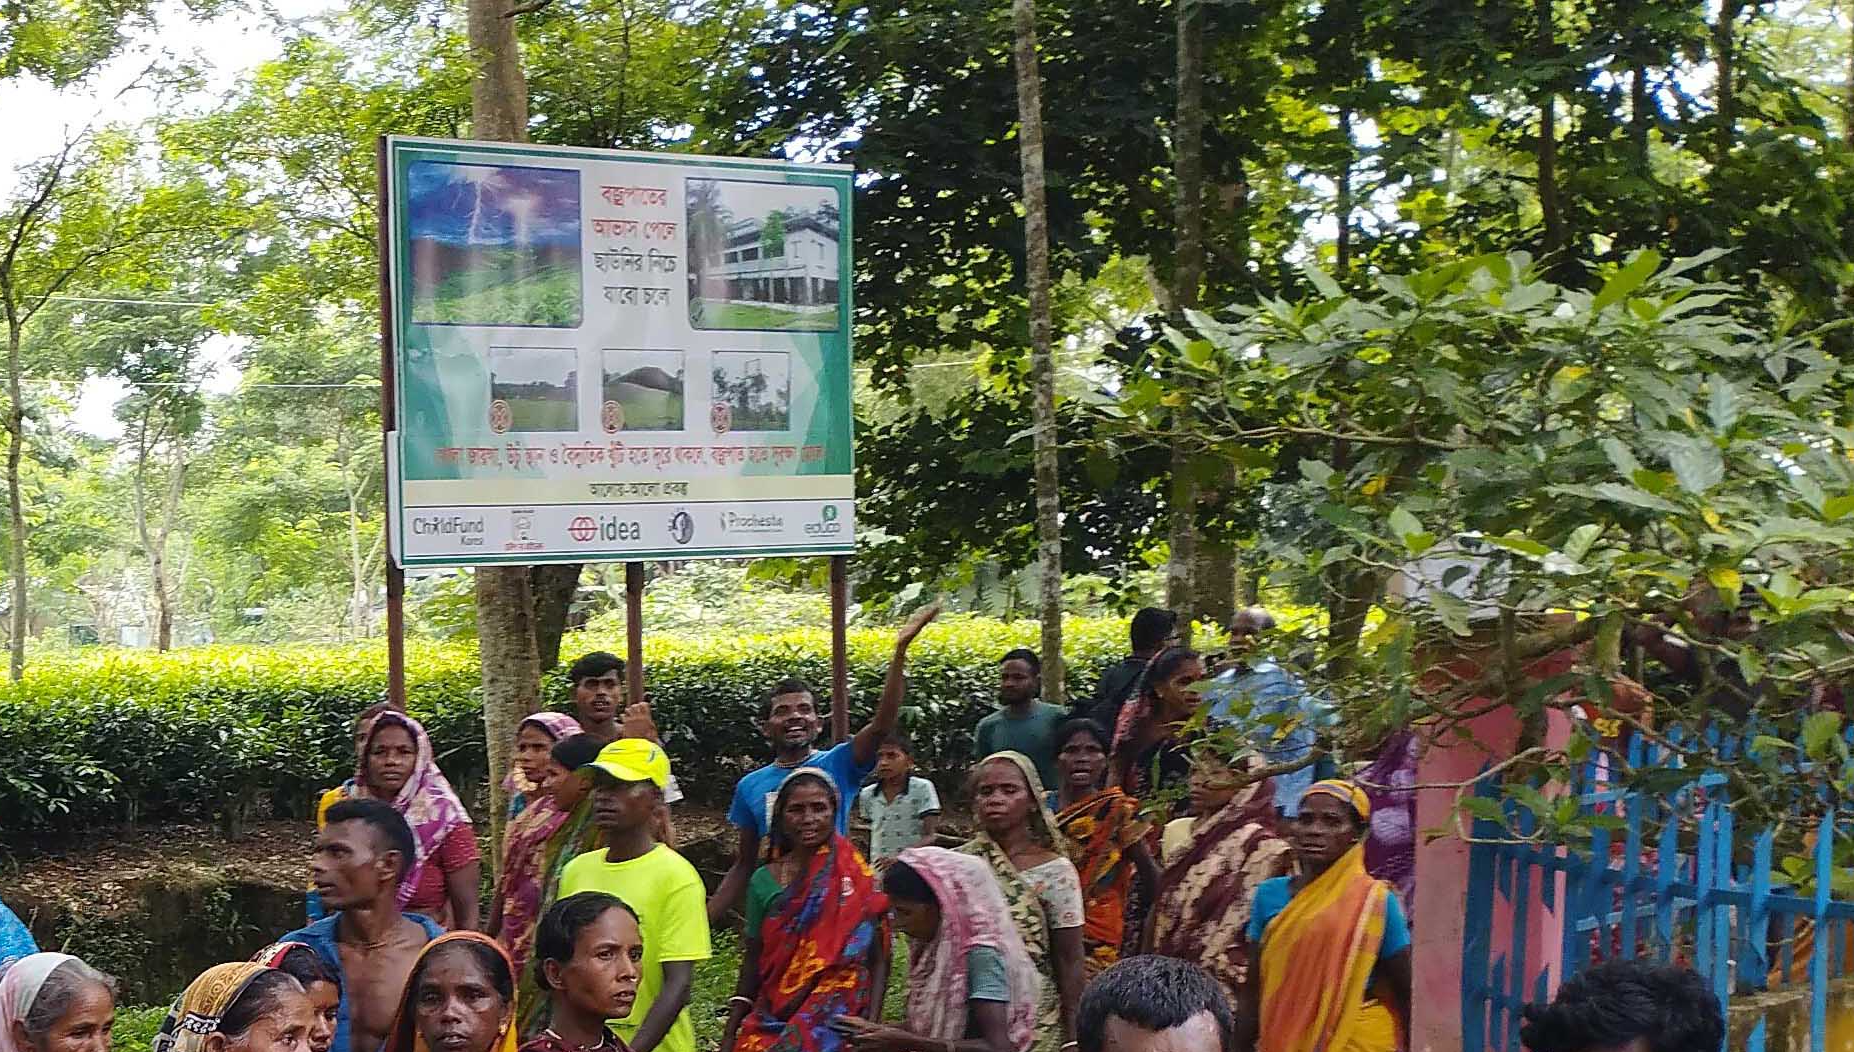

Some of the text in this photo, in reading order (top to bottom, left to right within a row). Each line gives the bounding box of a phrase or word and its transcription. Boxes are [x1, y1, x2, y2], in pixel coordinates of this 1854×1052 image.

[599, 185, 668, 208] বজ্রপাতের
[591, 218, 678, 240] আভাস পেলে
[592, 246, 678, 272] ছাউনির নিচে
[602, 286, 671, 305] যাবো চলে
[550, 448, 559, 464] ও
[412, 516, 484, 535] ChildFund
[600, 515, 641, 541] idea
